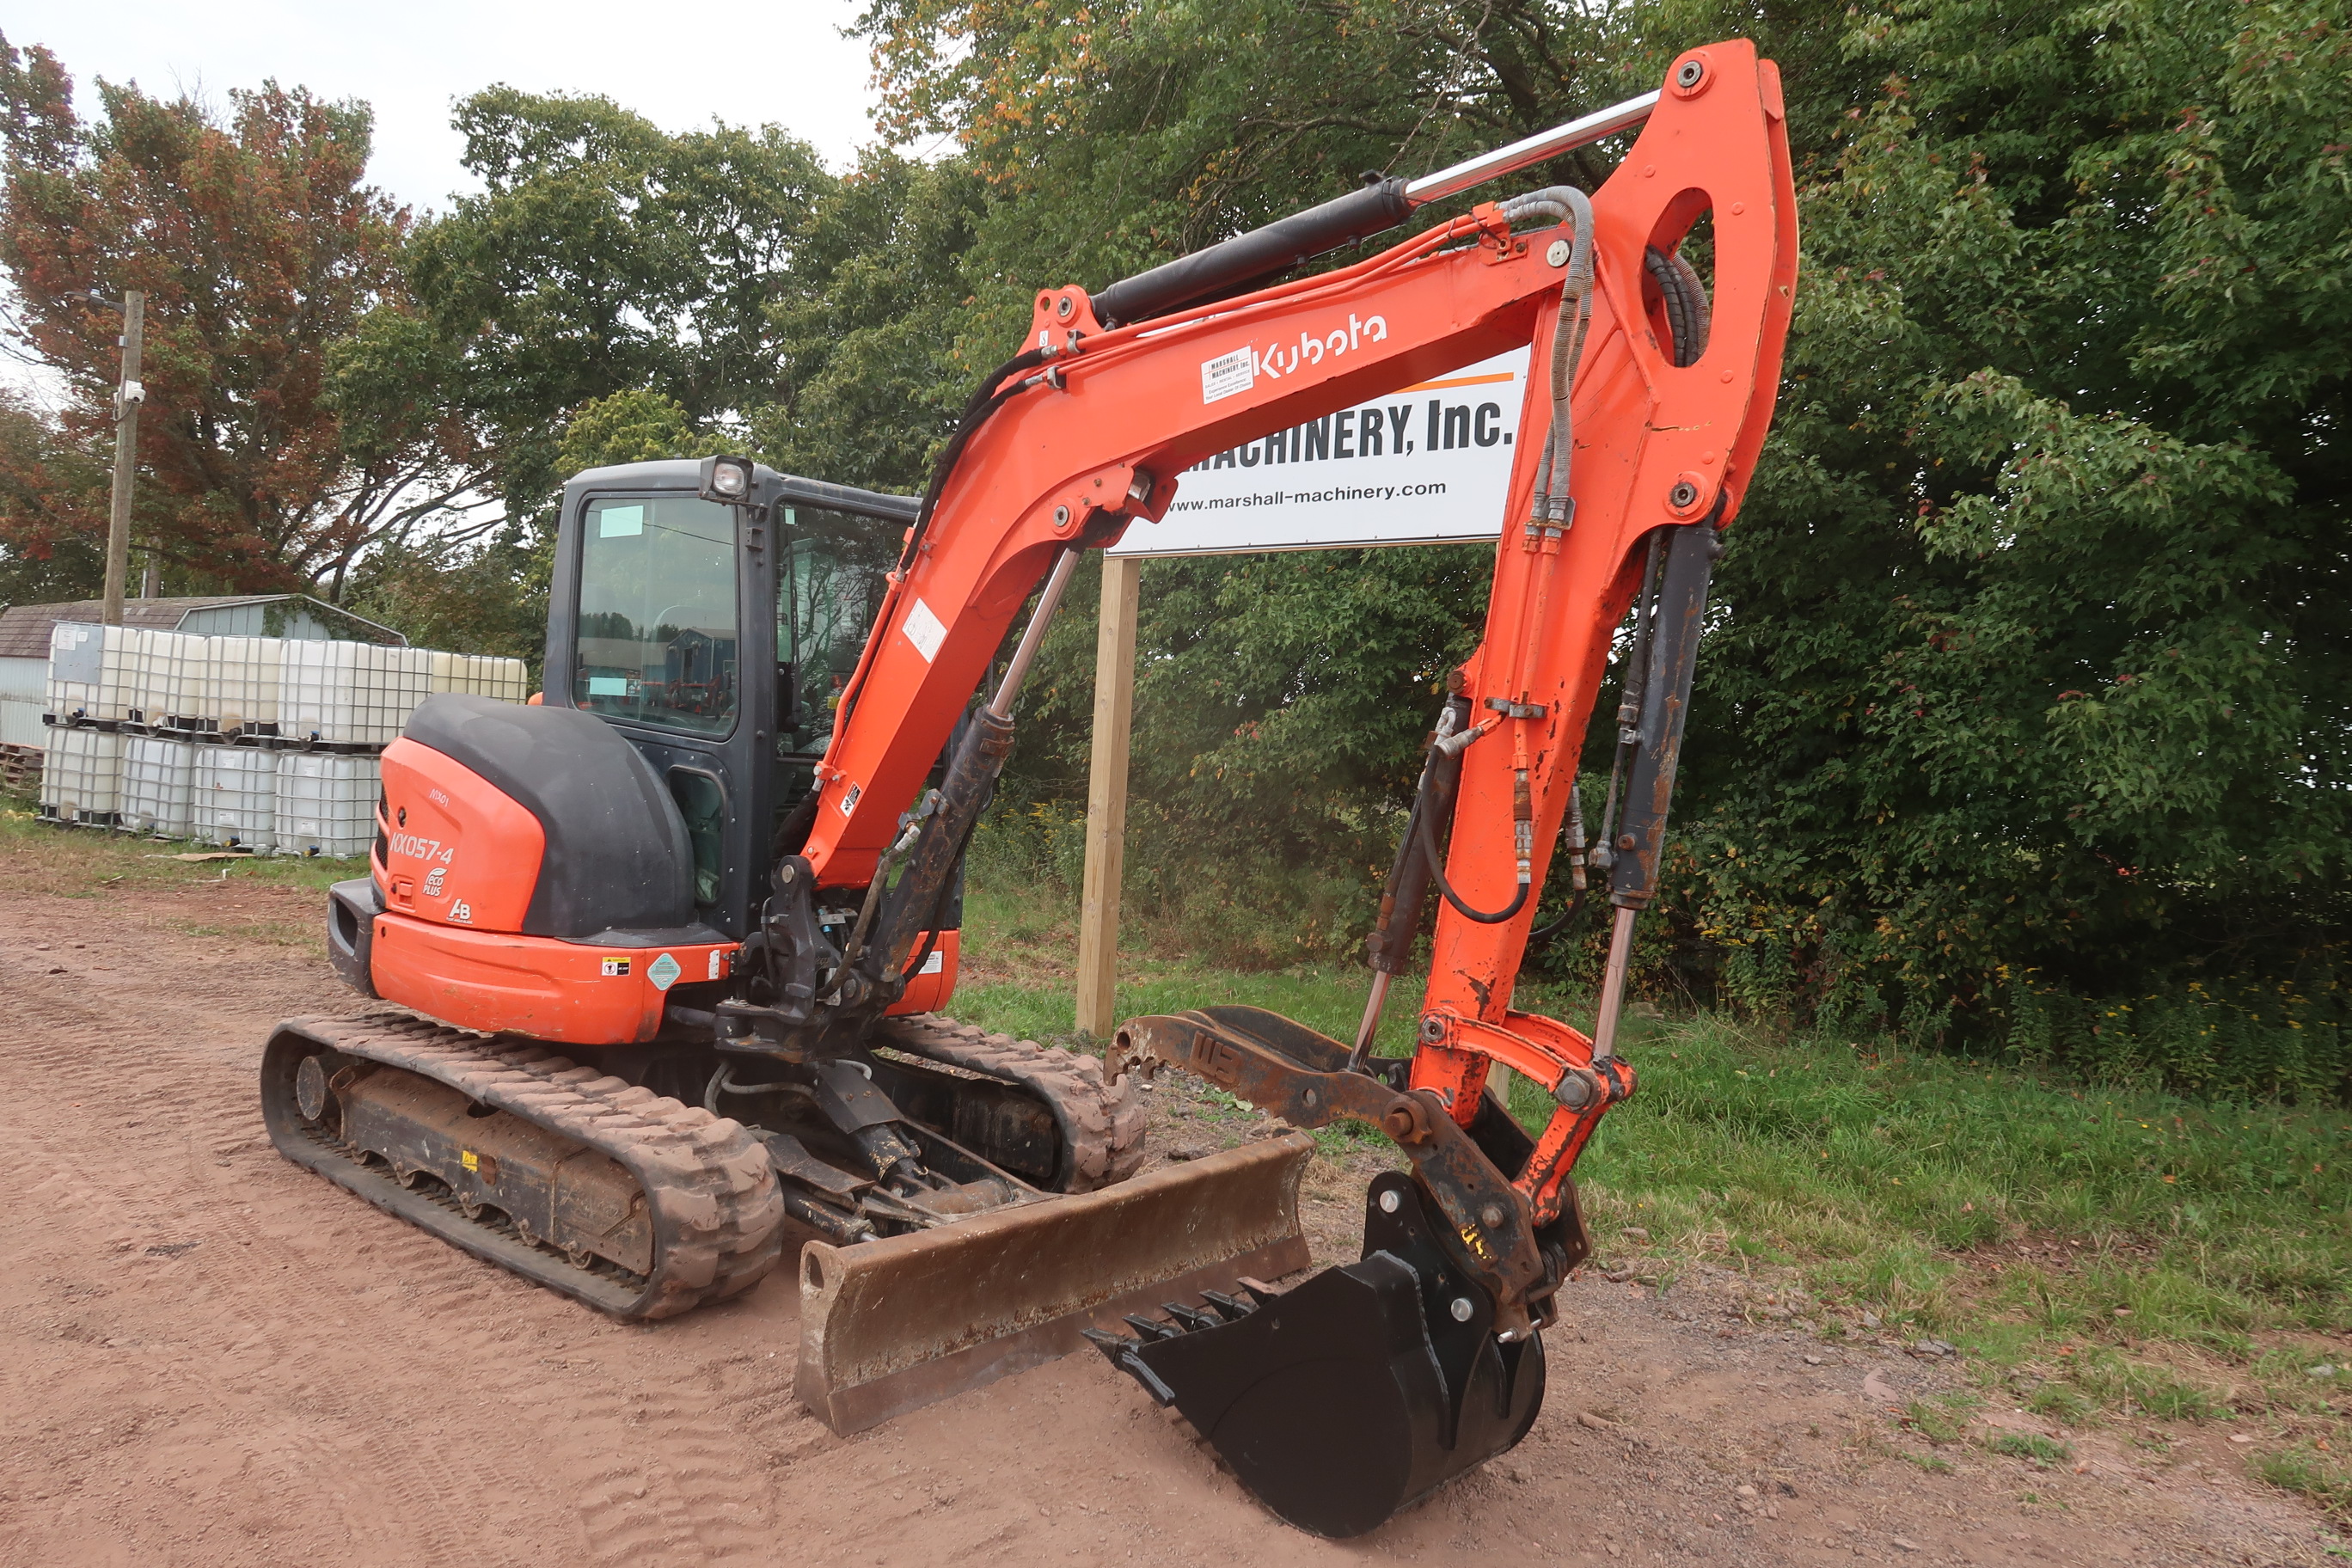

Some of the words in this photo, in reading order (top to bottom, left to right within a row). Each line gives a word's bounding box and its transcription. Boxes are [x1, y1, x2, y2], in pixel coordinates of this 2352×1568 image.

[1253, 313, 1387, 379] Kubota
[1211, 354, 1240, 371] MARSHALL
[1212, 364, 1240, 379] MACHINERY,
[1185, 404, 1414, 472] CHINERY,
[1427, 399, 1513, 451] Inc.
[389, 831, 455, 865] KX057-4
[429, 875, 444, 886] eco
[422, 884, 442, 897] PLUS
